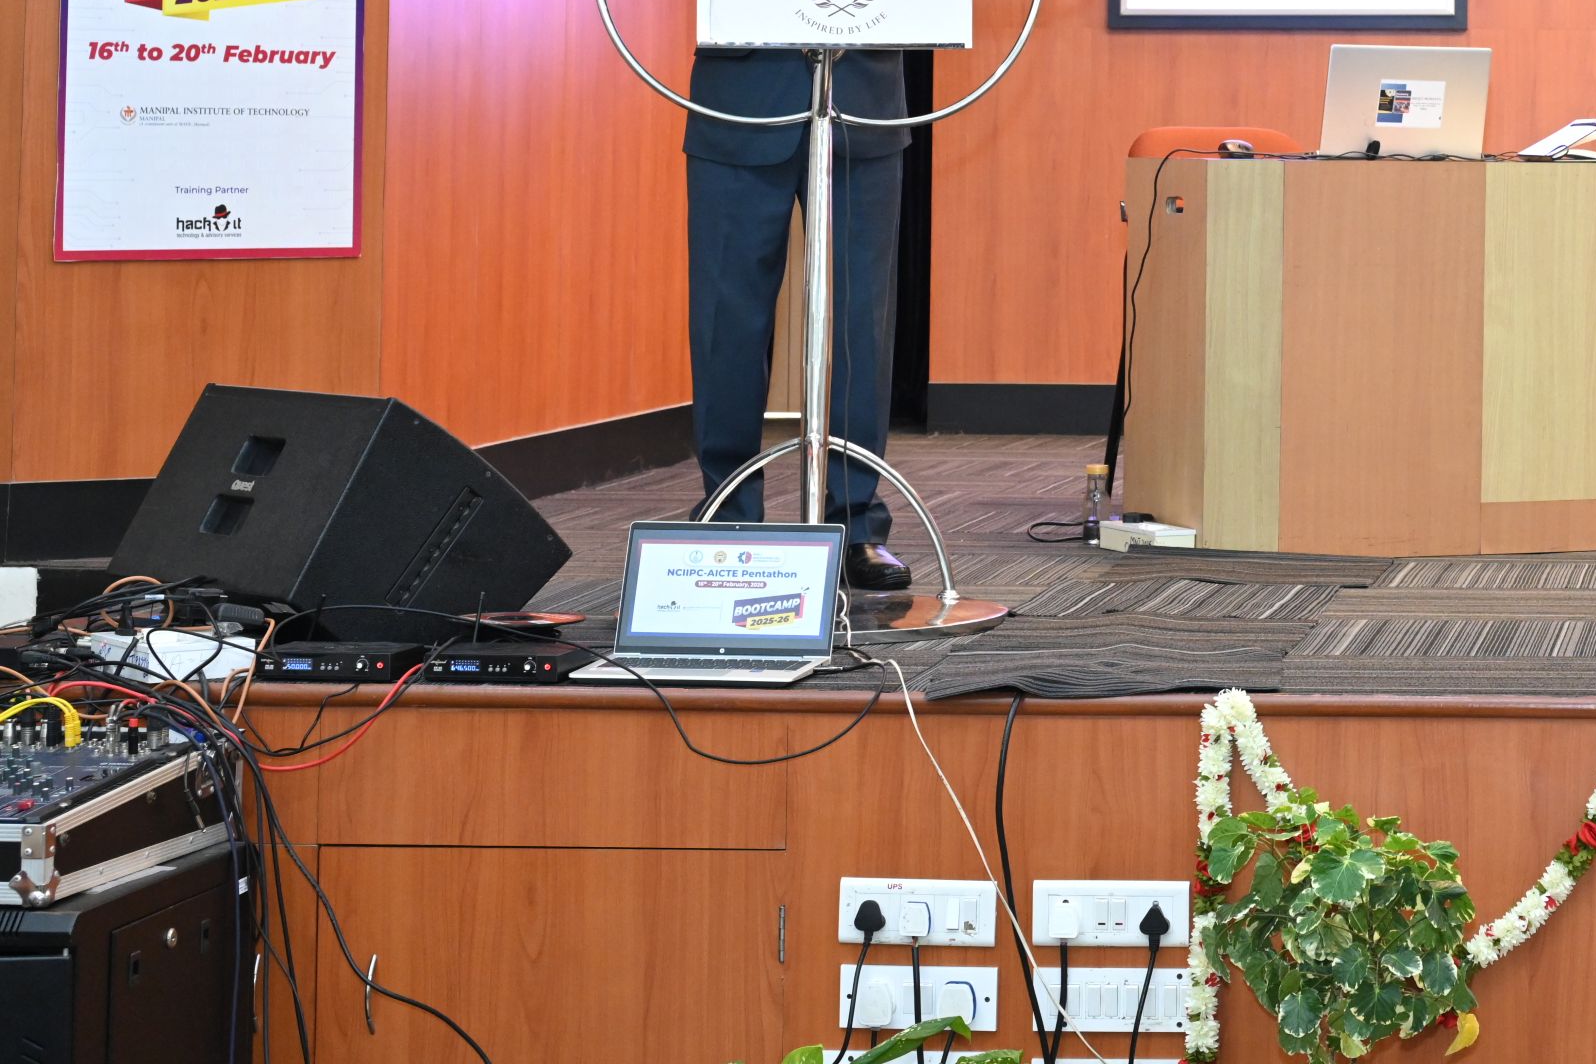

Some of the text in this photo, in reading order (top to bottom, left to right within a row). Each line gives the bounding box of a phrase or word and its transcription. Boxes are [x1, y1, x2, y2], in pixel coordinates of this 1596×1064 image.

[795, 9, 888, 35] INSPIRED BY LIFE
[88, 41, 336, 69] 16th to 20th February
[139, 106, 310, 117] MANIPAL INSTITUTE OF TECHNOLOGY
[175, 186, 213, 195] Training
[667, 568, 797, 579] NCIIPC-AICTE Pentathon
[734, 598, 800, 617] BOOTCAMP
[750, 616, 790, 626] 2025-26
